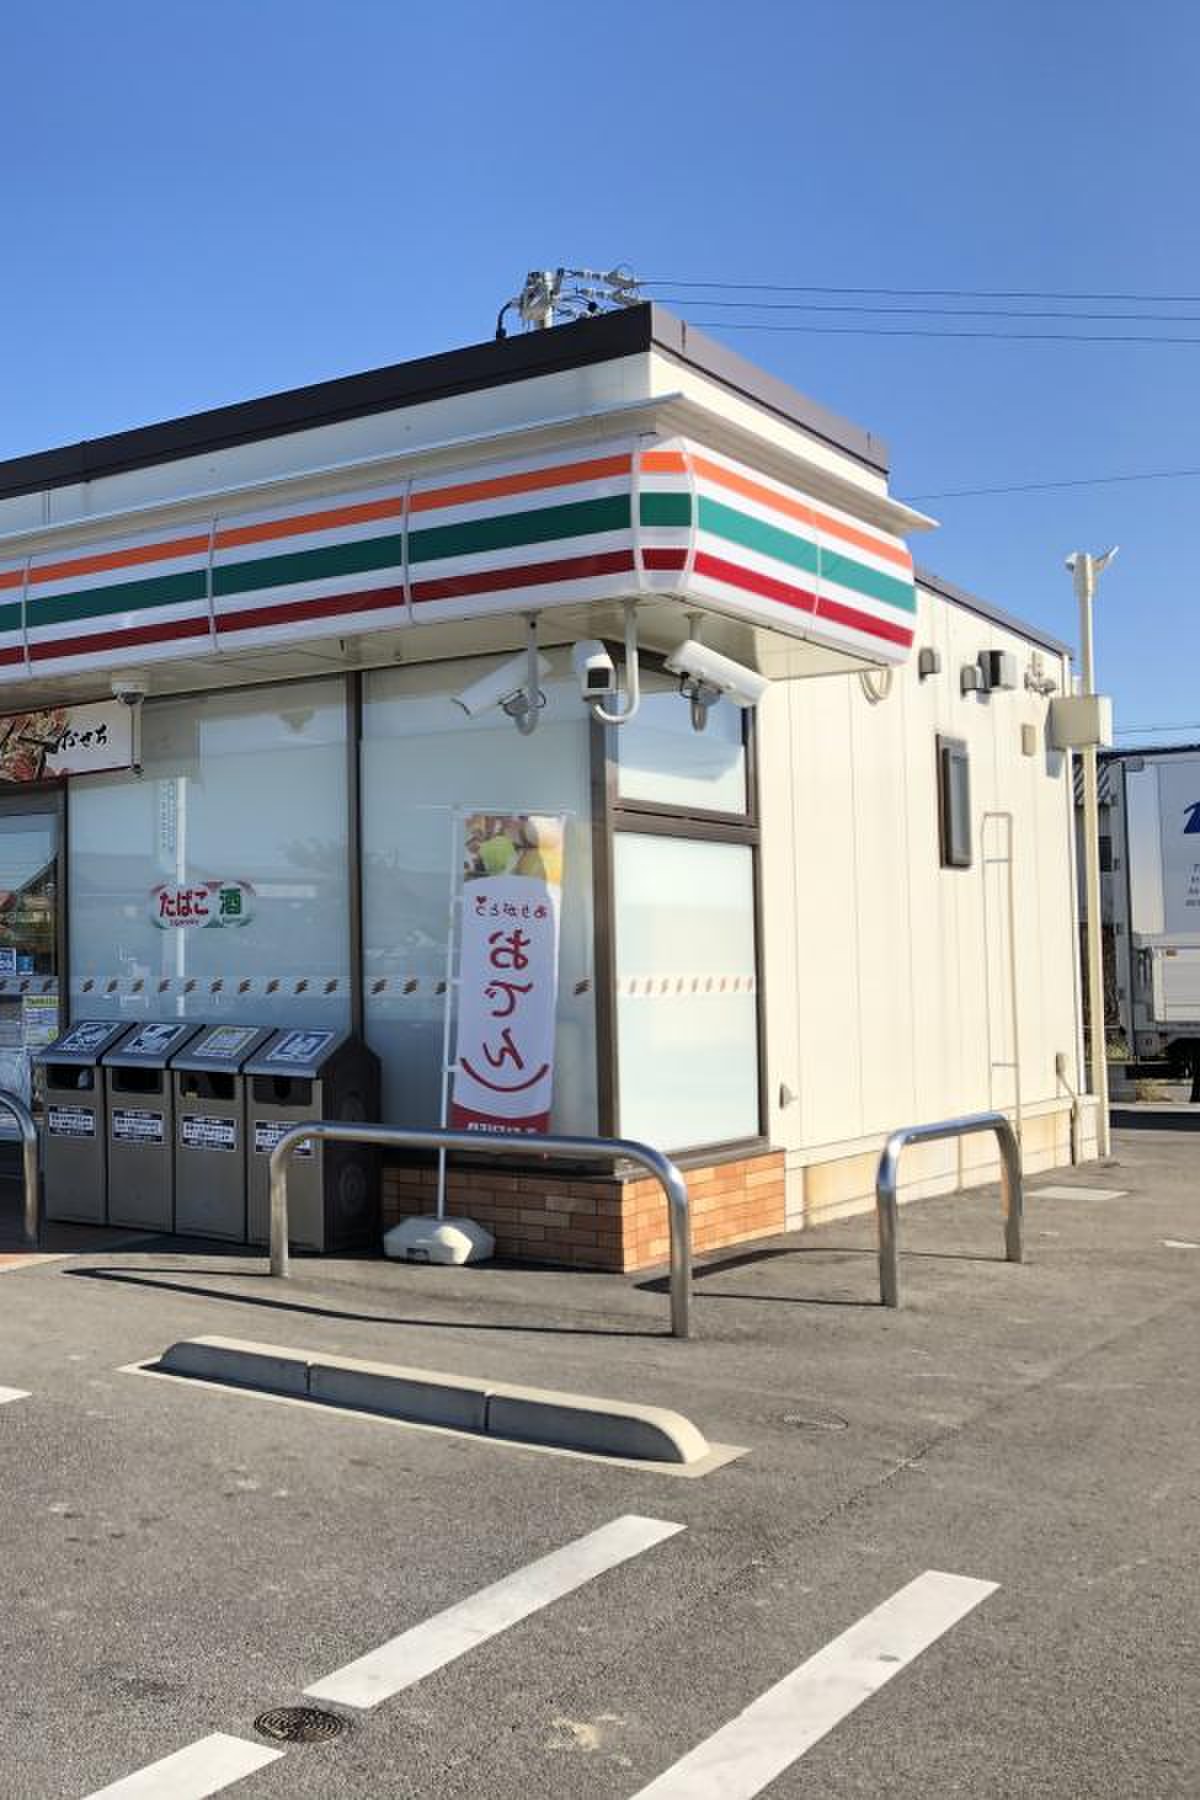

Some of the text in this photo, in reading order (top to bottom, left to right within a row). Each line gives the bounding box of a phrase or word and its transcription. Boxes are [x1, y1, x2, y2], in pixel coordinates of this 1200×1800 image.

[159, 888, 242, 918] たばこ 酒
